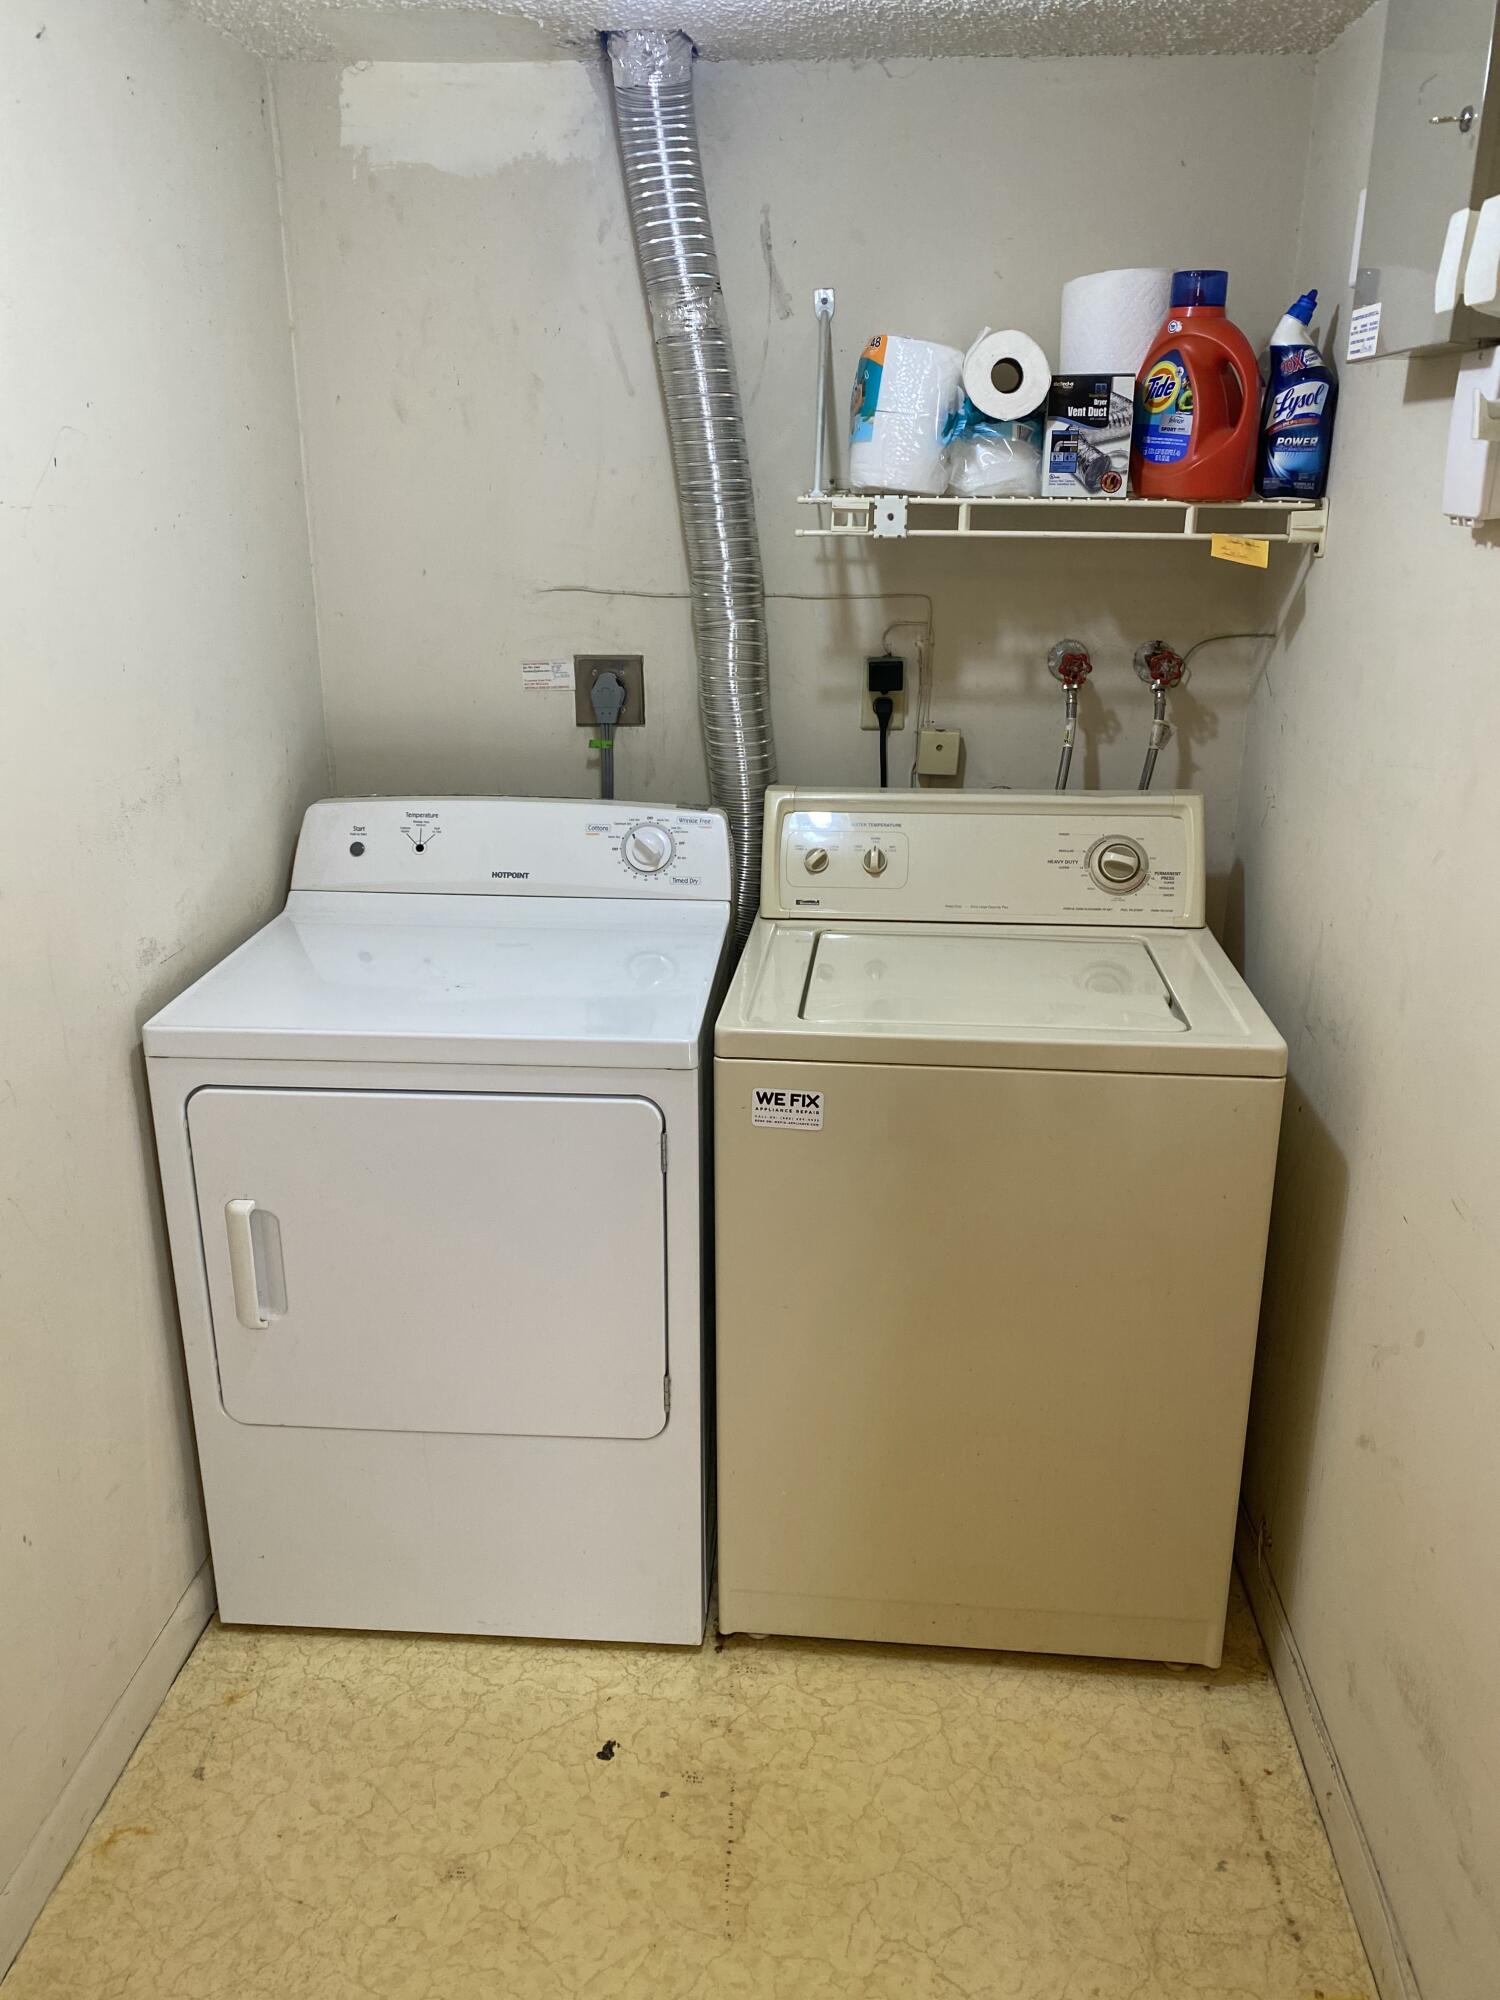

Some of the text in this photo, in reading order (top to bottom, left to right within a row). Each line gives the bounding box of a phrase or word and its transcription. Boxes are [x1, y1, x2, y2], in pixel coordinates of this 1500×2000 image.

[870, 336, 882, 347] 48
[1144, 375, 1177, 404] Tide
[1273, 383, 1325, 419] Lysol
[1067, 406, 1107, 417] Vent Duct
[1275, 436, 1318, 447] POWER
[405, 811, 439, 819] Temperature
[491, 871, 530, 879] HOTPOINT
[756, 1091, 820, 1109] WE FIX
